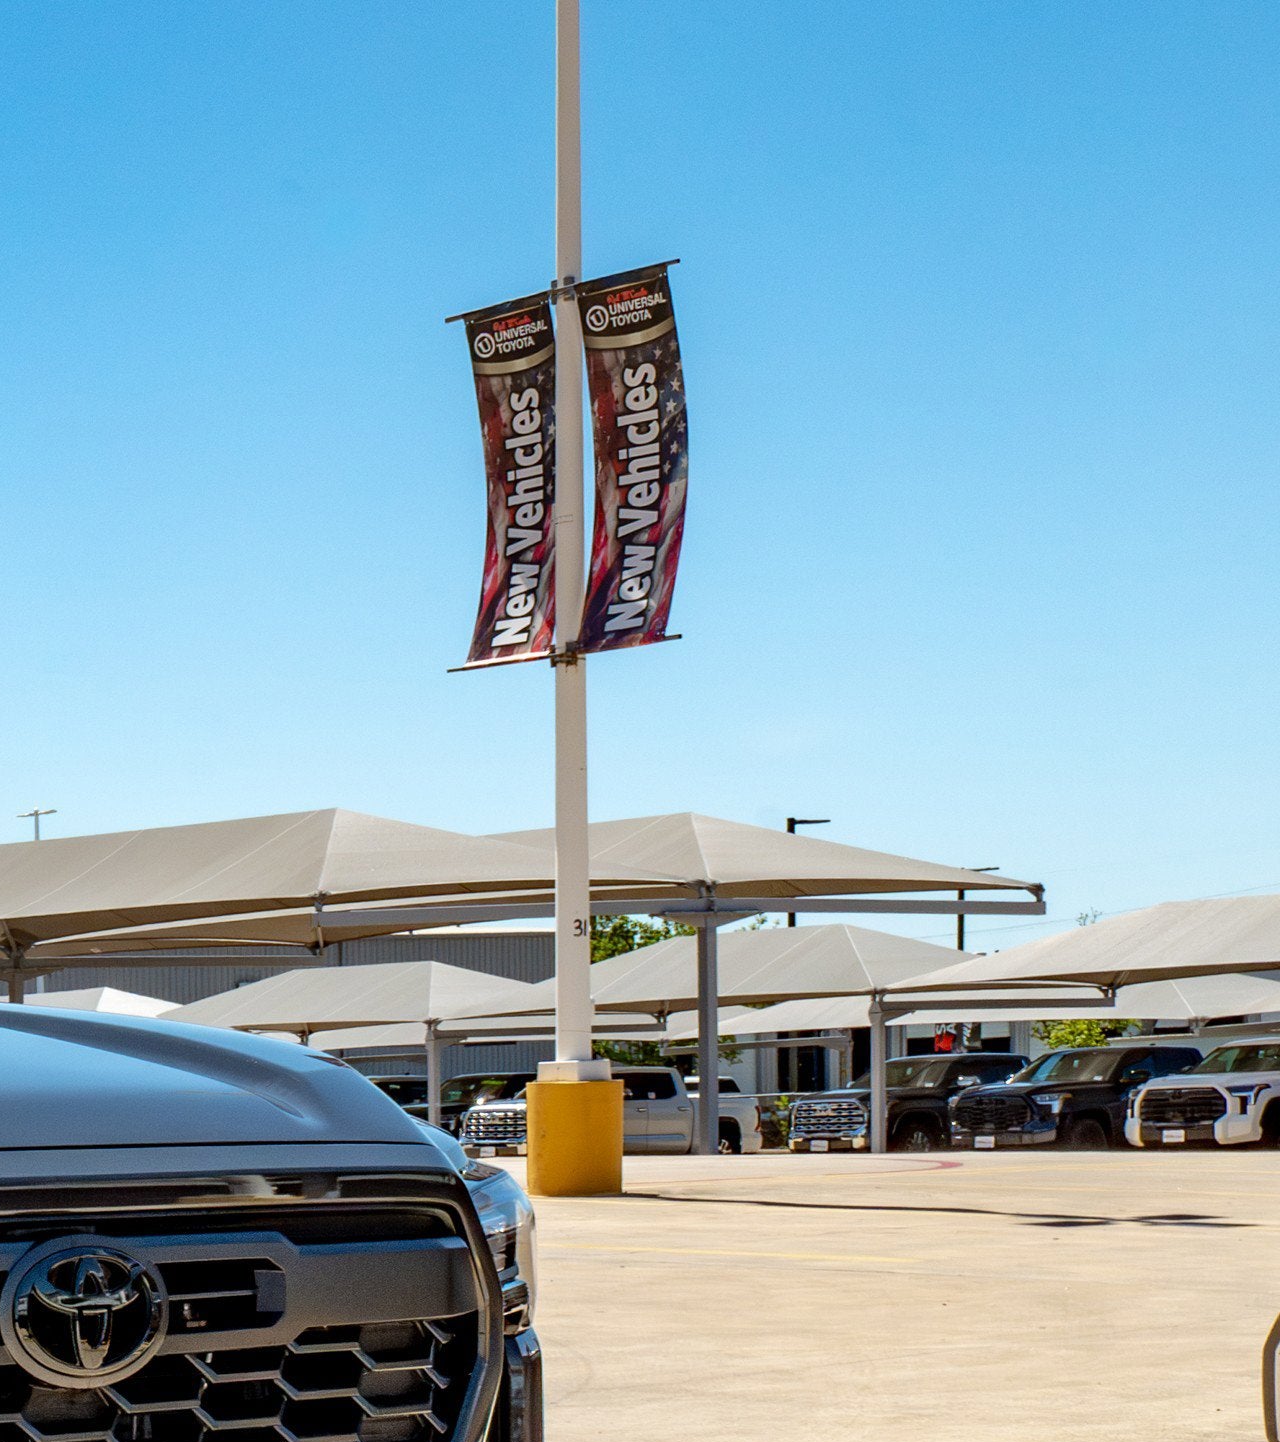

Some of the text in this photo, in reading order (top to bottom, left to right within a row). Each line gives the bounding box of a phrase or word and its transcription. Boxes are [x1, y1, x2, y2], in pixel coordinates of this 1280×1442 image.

[608, 292, 667, 316] UNIVERSAL
[610, 309, 652, 328] TOYOTA
[494, 319, 548, 342] UNIVERSAL
[496, 336, 535, 354] TOYOTA
[616, 361, 661, 539] Vehicles
[492, 387, 545, 649] New Vehicles
[603, 543, 656, 634] New
[573, 918, 587, 937] 31
